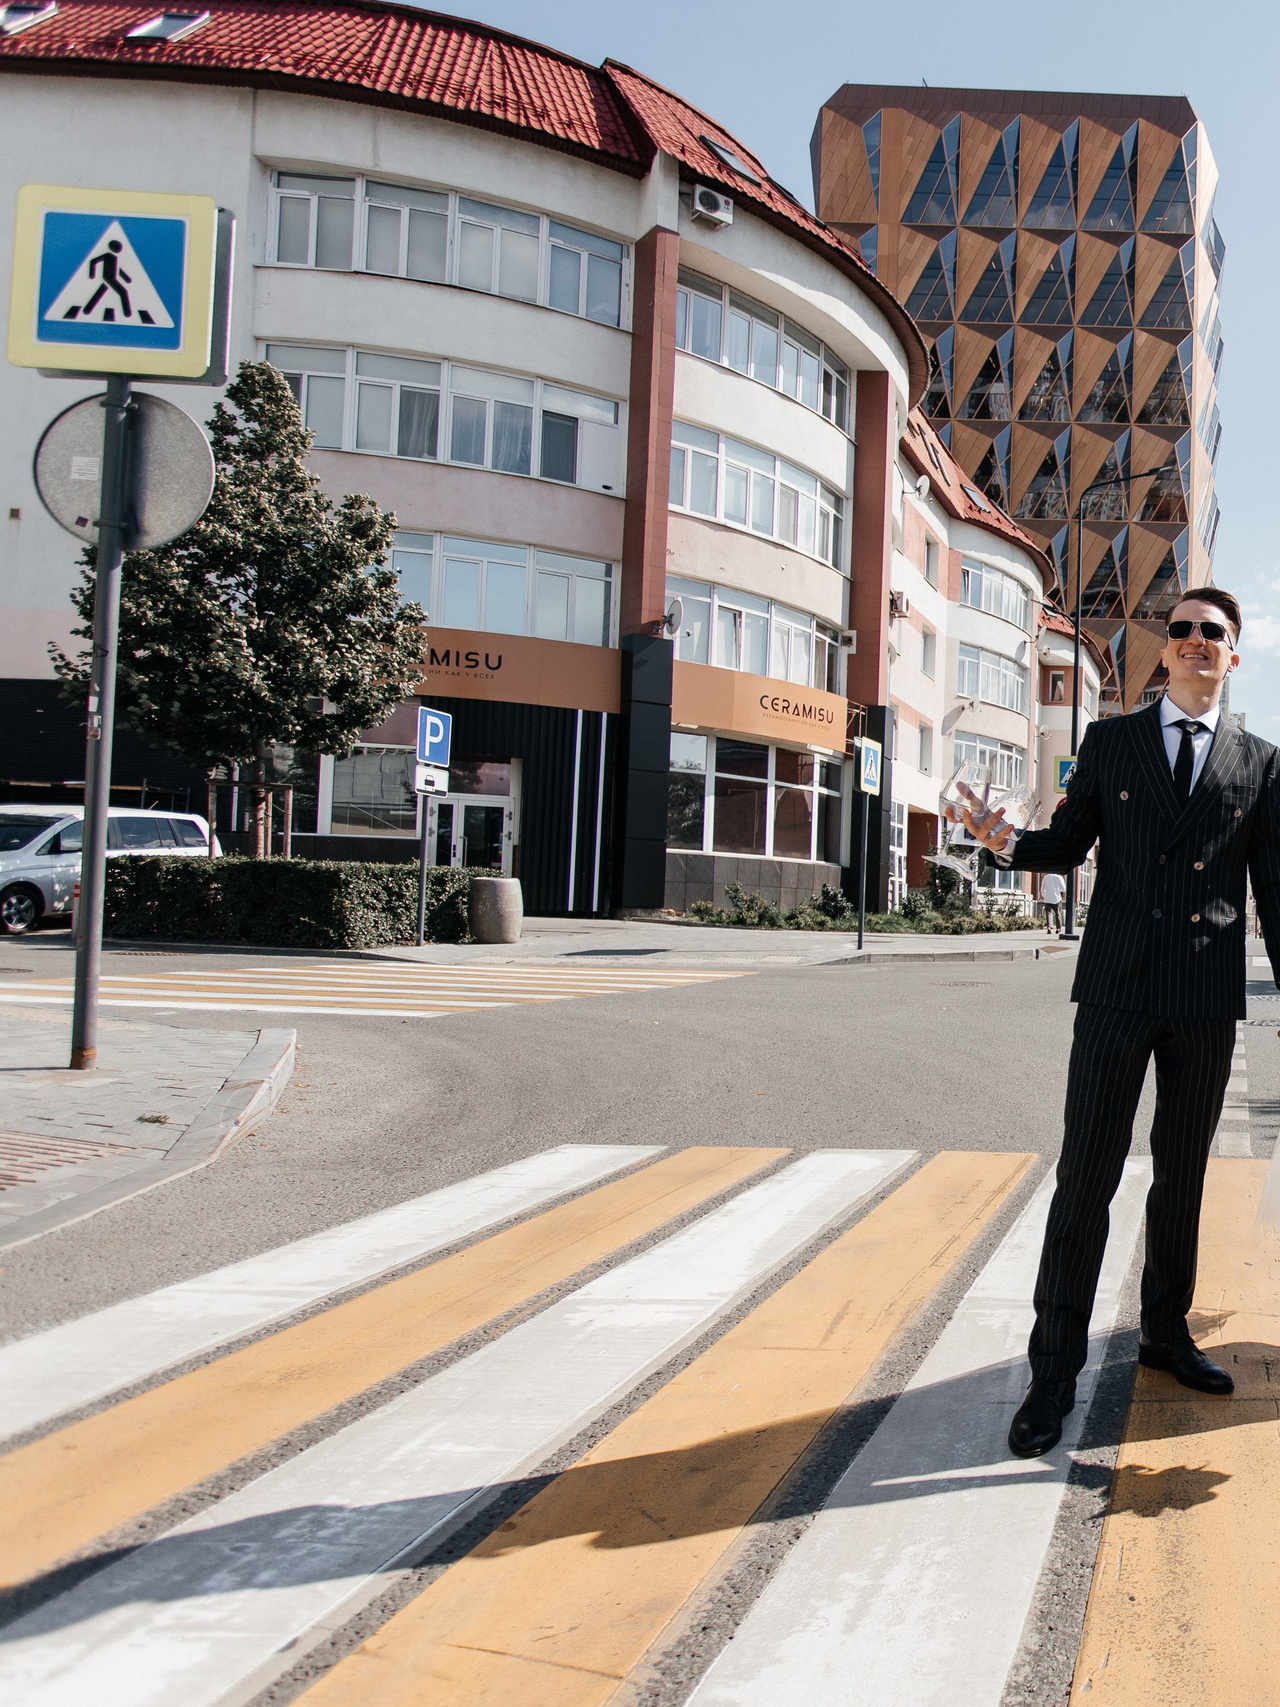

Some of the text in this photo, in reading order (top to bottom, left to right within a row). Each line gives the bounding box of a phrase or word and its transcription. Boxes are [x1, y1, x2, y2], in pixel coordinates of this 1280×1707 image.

[418, 648, 502, 671] MISU
[760, 695, 834, 724] CERAMISU
[425, 715, 444, 757] P
